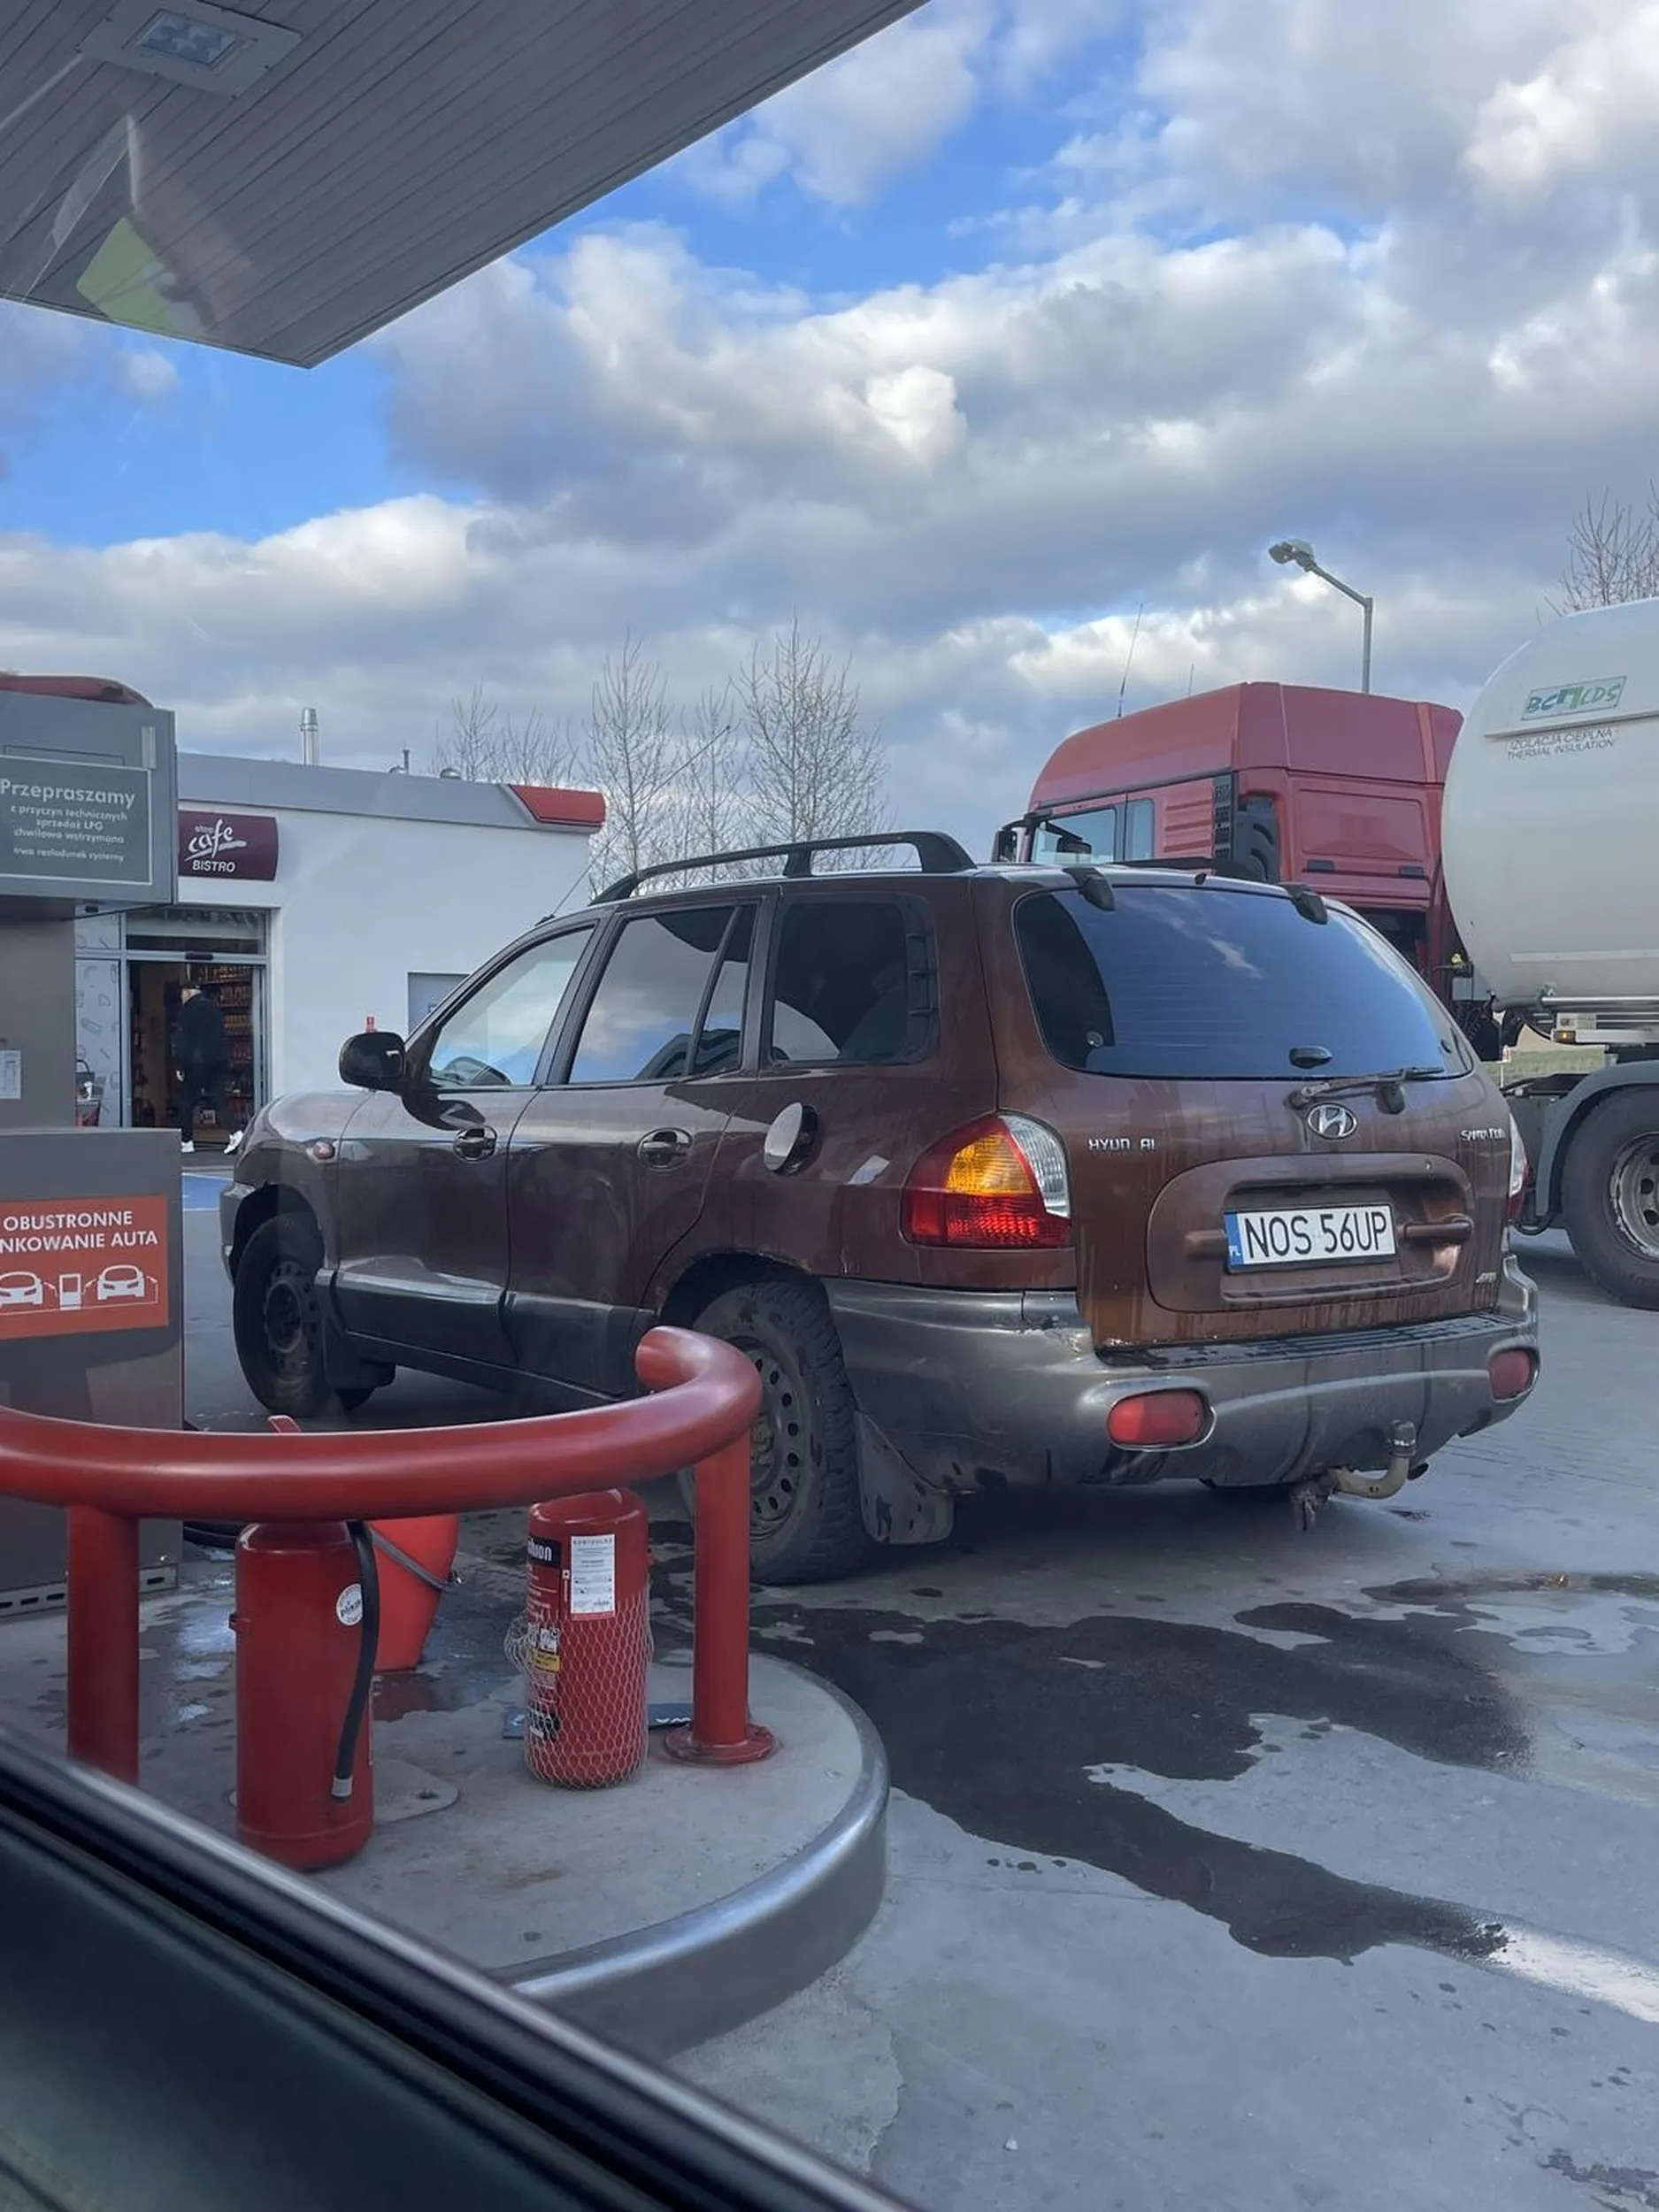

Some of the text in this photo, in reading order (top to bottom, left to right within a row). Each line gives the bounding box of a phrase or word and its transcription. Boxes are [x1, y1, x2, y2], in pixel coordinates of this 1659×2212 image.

[1510, 727, 1613, 749] IZOLACJA CIEPLNA
[1507, 740, 1614, 760] THERMAL INSULATION
[0, 778, 135, 810] Przepraszamy
[19, 806, 64, 818] przyczyn
[65, 809, 127, 822] technicznych
[84, 820, 104, 831] LPG
[65, 832, 124, 845] wstrzymana
[188, 818, 234, 858] cafe
[192, 859, 236, 873] BISTRO
[4, 1210, 134, 1232] OBUSTRONNE
[111, 1230, 158, 1248] AUTA
[1243, 1210, 1388, 1259] NOS 56UP
